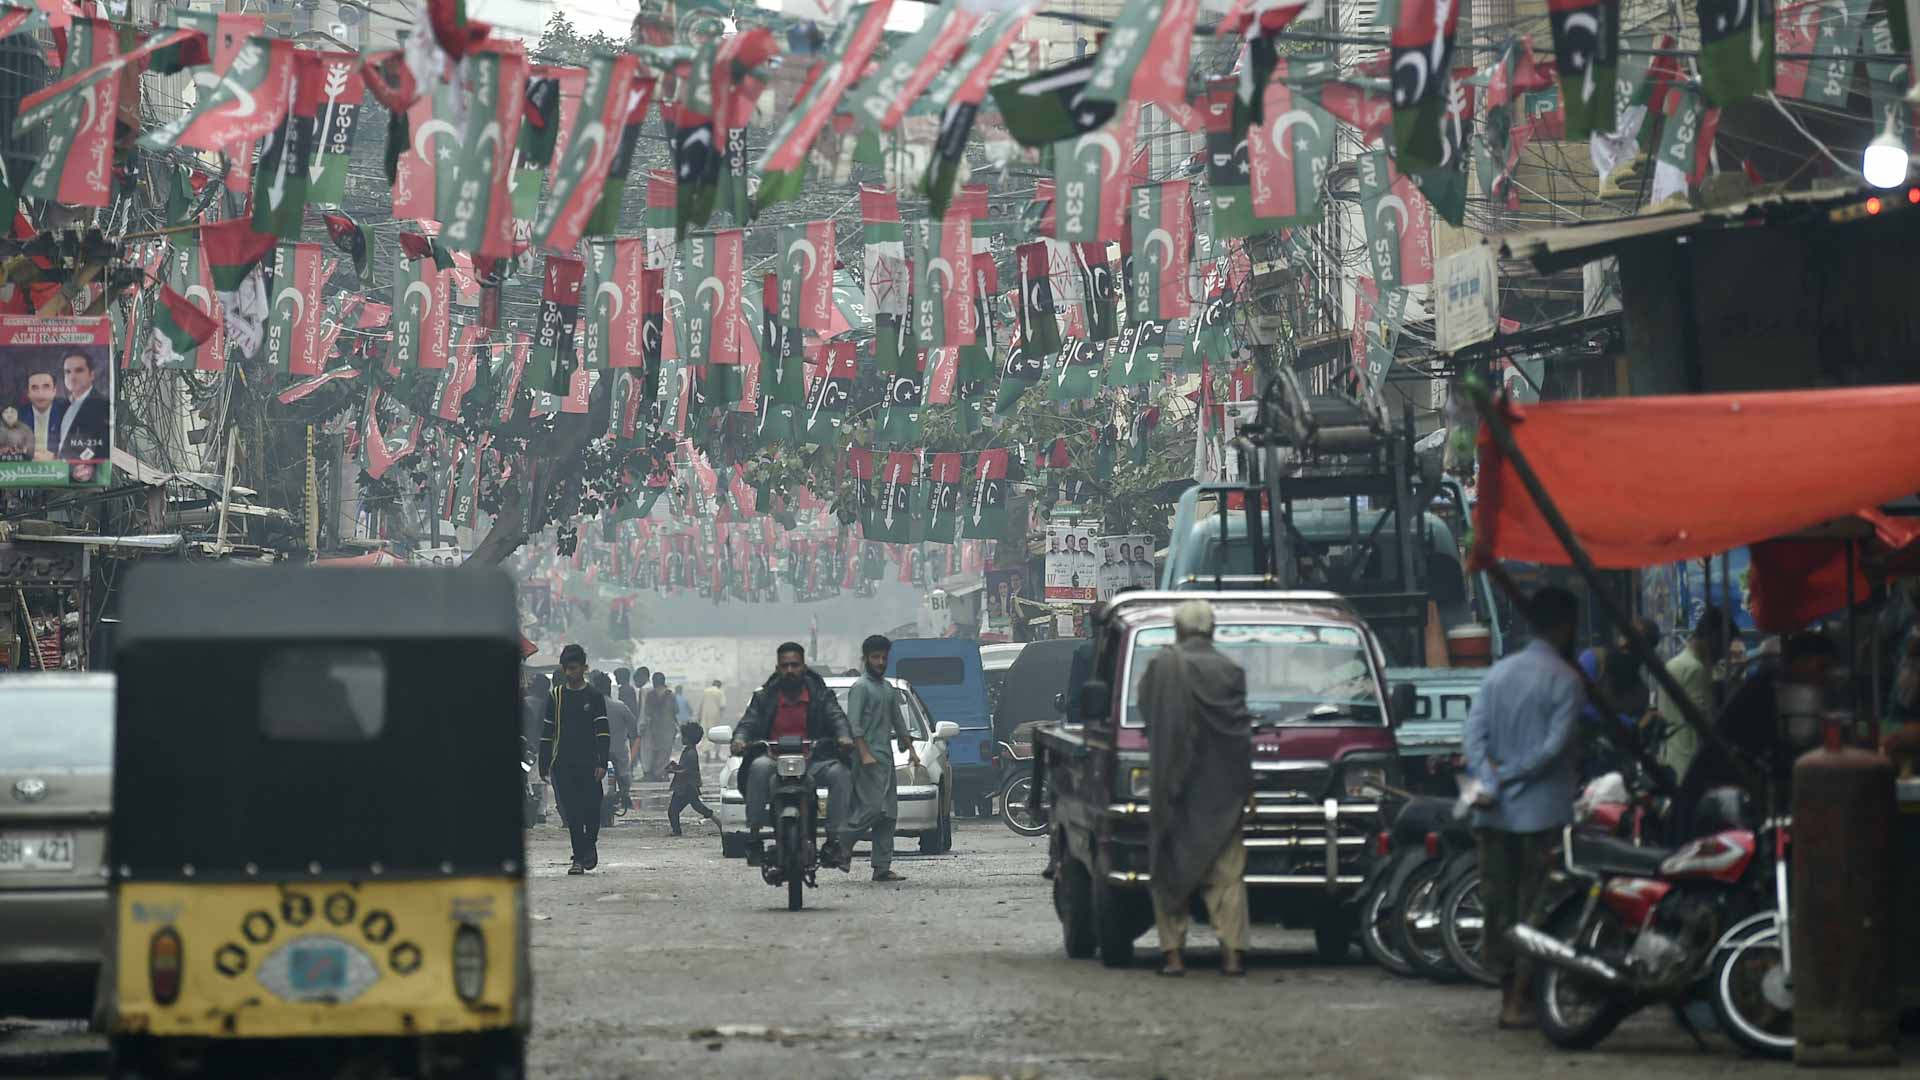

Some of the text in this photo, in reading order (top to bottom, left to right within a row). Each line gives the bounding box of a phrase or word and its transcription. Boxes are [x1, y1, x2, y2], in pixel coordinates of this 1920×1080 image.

[540, 300, 557, 347] PS-95
[11, 333, 36, 344] ALI
[1119, 328, 1133, 353] S-95
[1056, 336, 1074, 367] PS-95
[882, 374, 895, 409] PS-95
[70, 439, 103, 447] NA-234
[38, 841, 69, 862] 421
